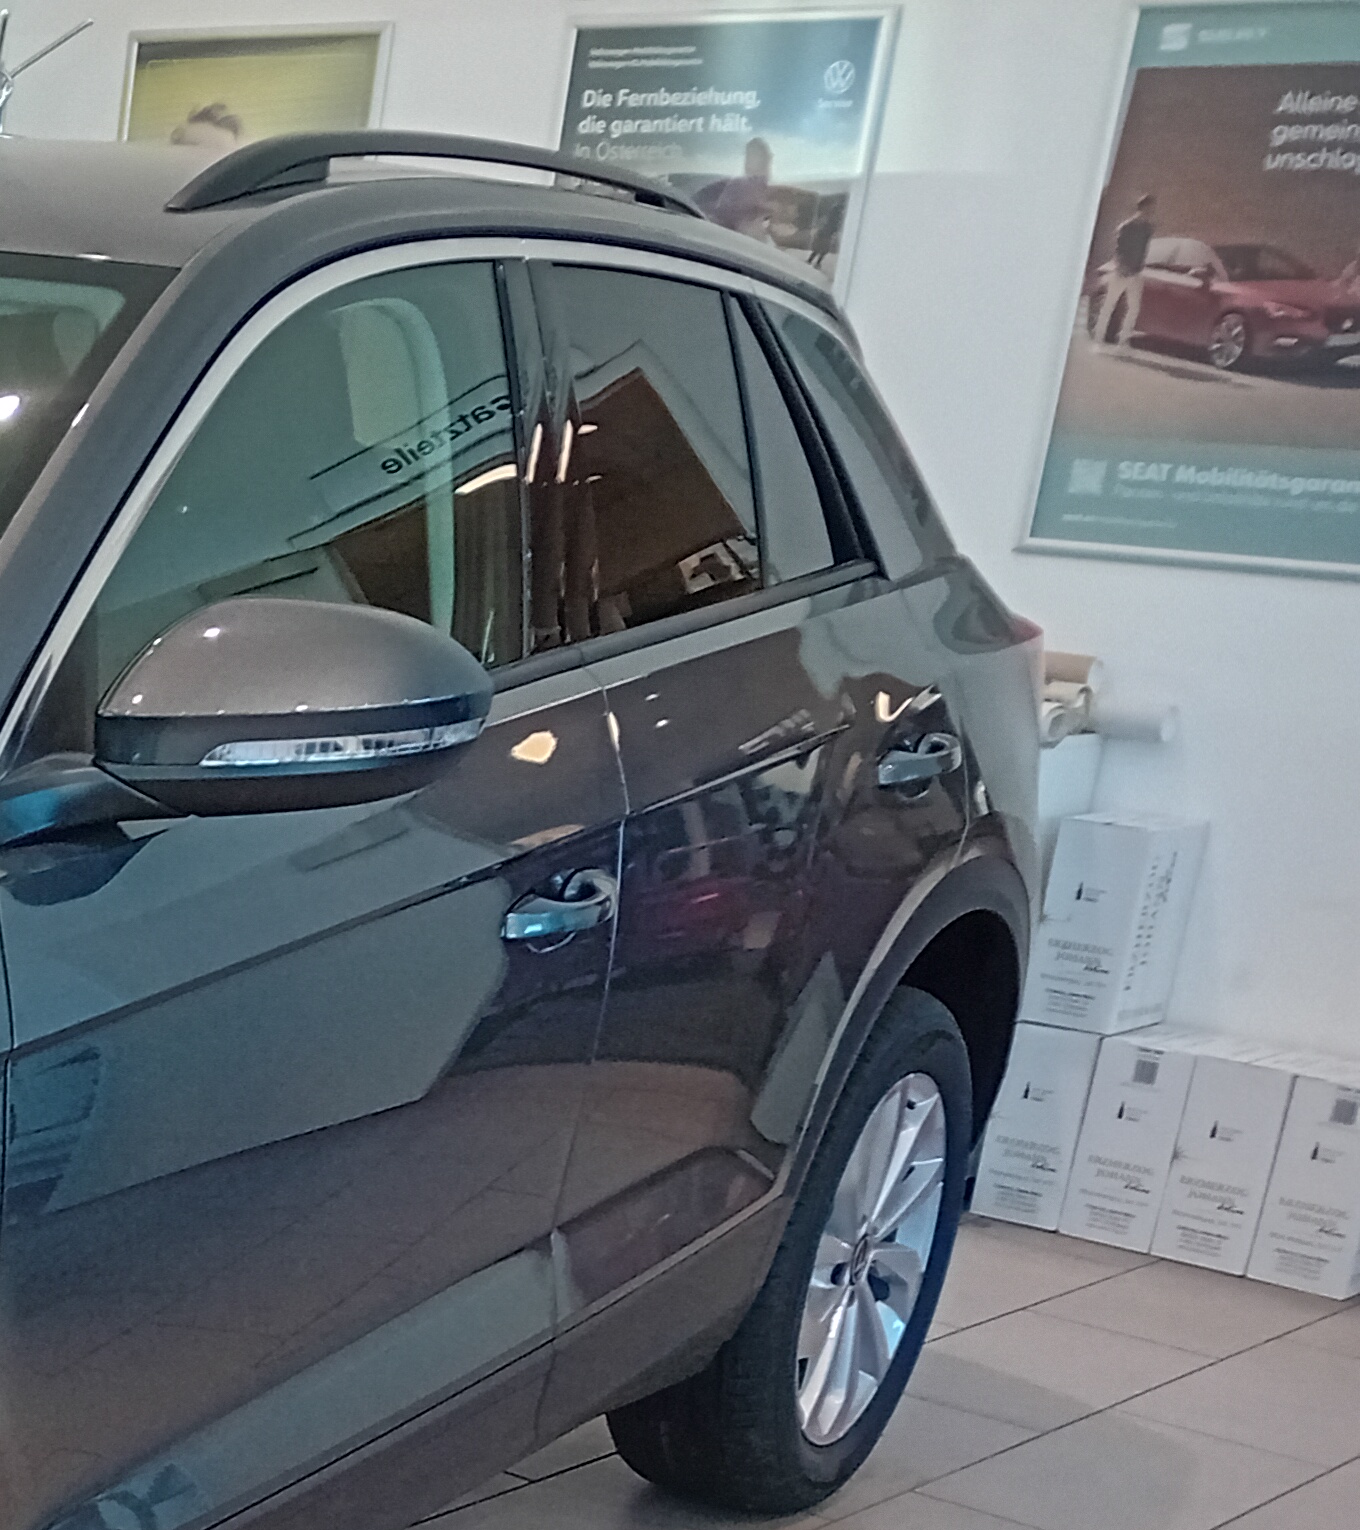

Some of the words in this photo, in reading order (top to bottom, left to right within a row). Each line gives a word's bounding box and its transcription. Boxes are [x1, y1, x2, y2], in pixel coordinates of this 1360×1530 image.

[581, 88, 613, 109] Die
[616, 86, 761, 109] Fernbeziehung,
[1274, 90, 1359, 115] Alleine
[578, 115, 607, 135] die
[610, 114, 704, 138] garantiert
[708, 112, 753, 133] hält.
[1117, 460, 1173, 481] SEAT
